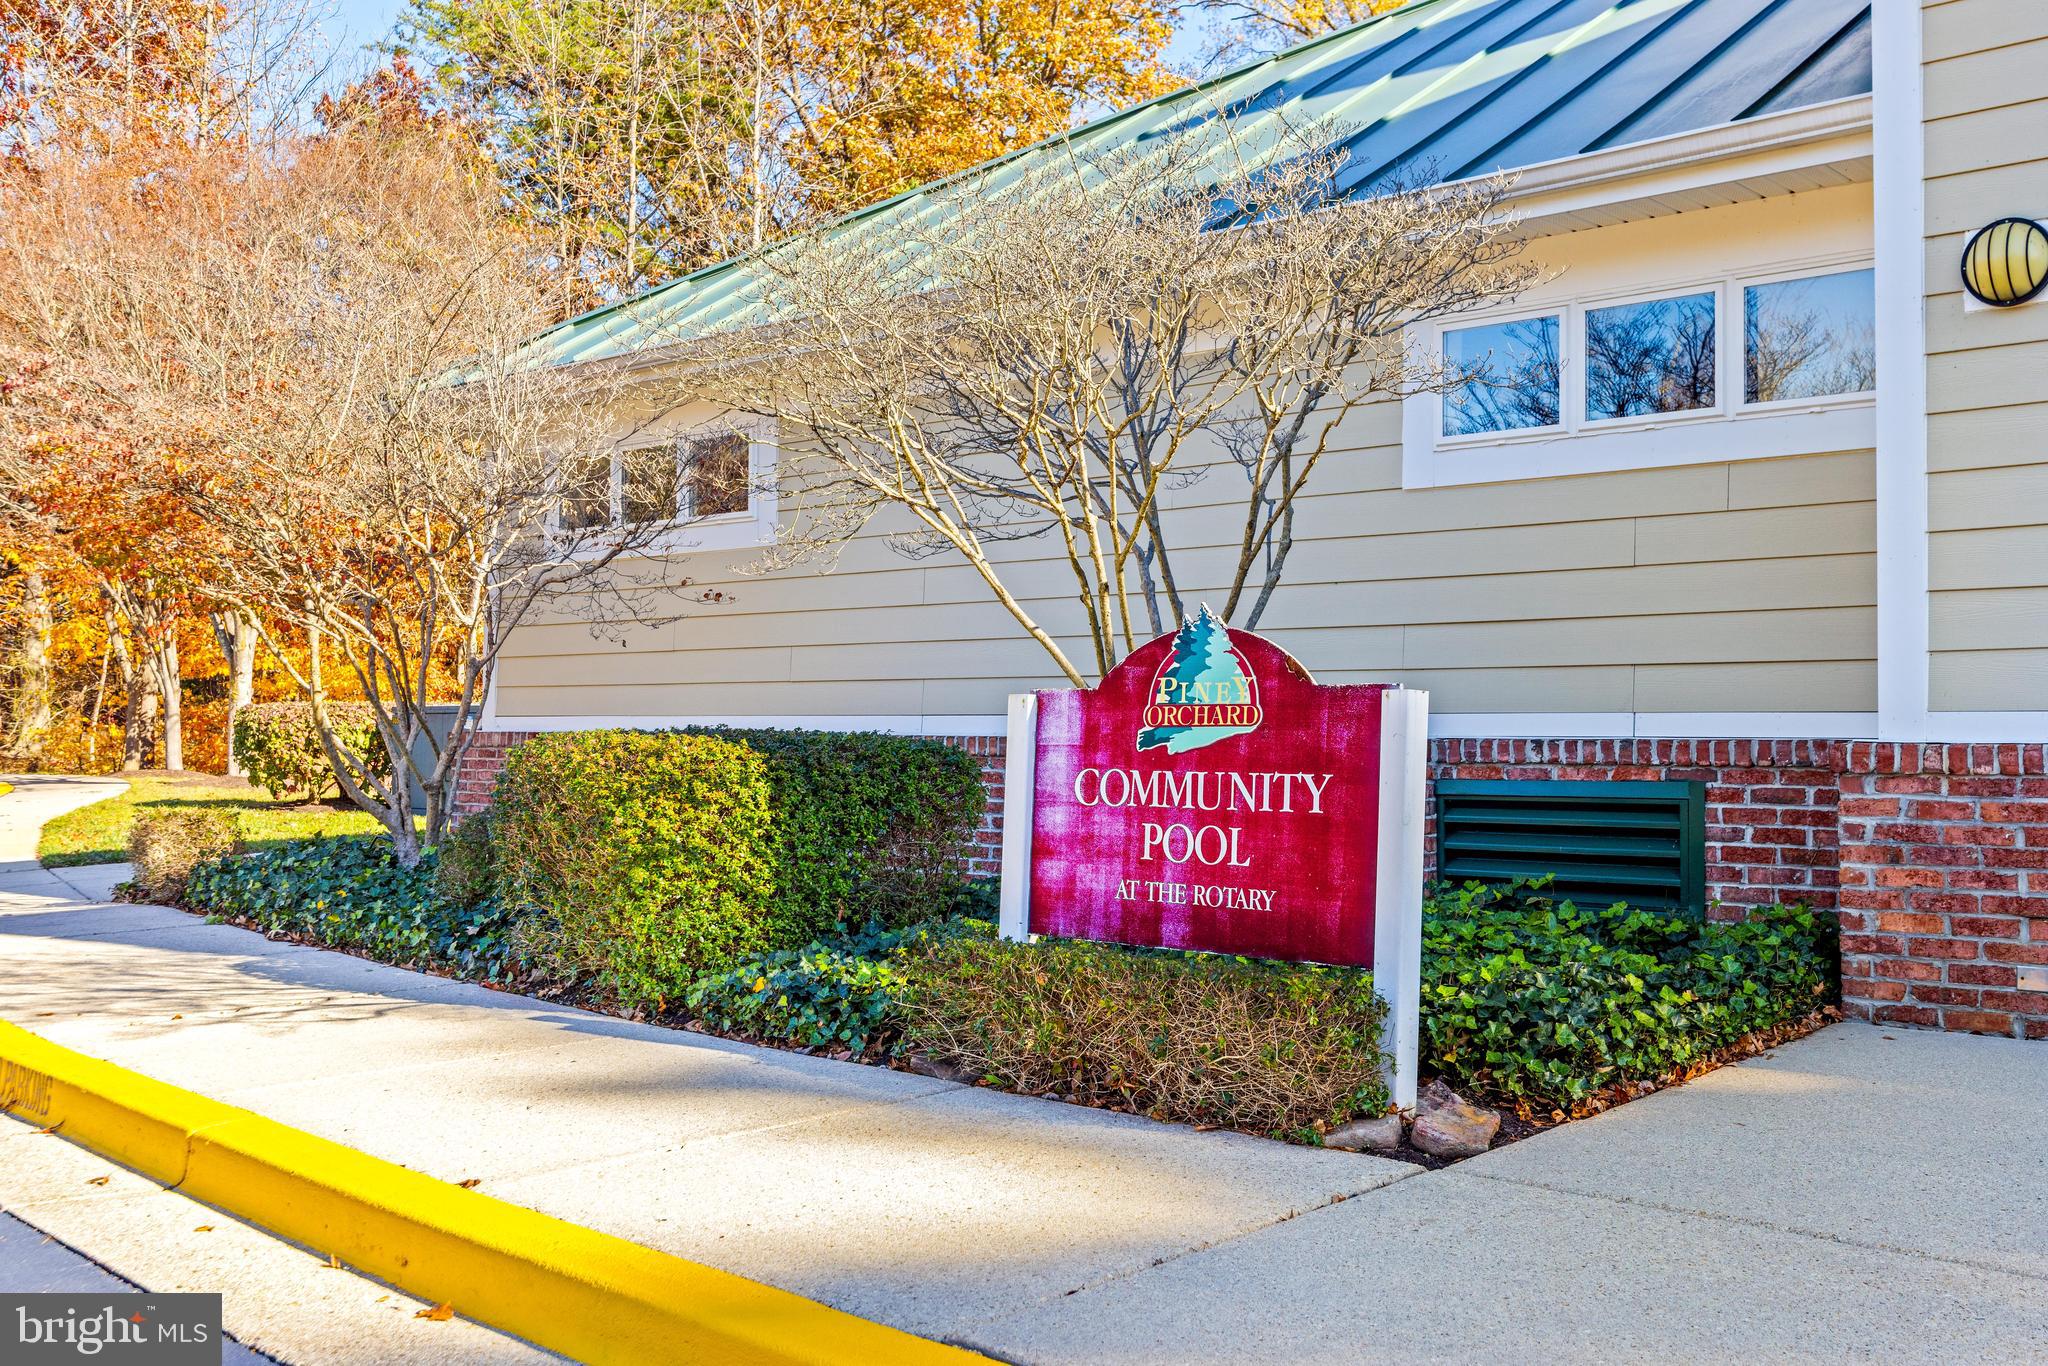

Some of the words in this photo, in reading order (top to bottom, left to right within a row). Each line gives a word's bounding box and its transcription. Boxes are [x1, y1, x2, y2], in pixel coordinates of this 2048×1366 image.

[1157, 676, 1254, 705] PINEY
[1147, 705, 1259, 726] ORCHARD
[1074, 768, 1334, 814] COMMUNITY
[1140, 823, 1250, 867] POOL
[1115, 880, 1139, 901] AT
[1145, 881, 1187, 905] THE
[1193, 884, 1277, 912] ROTARY
